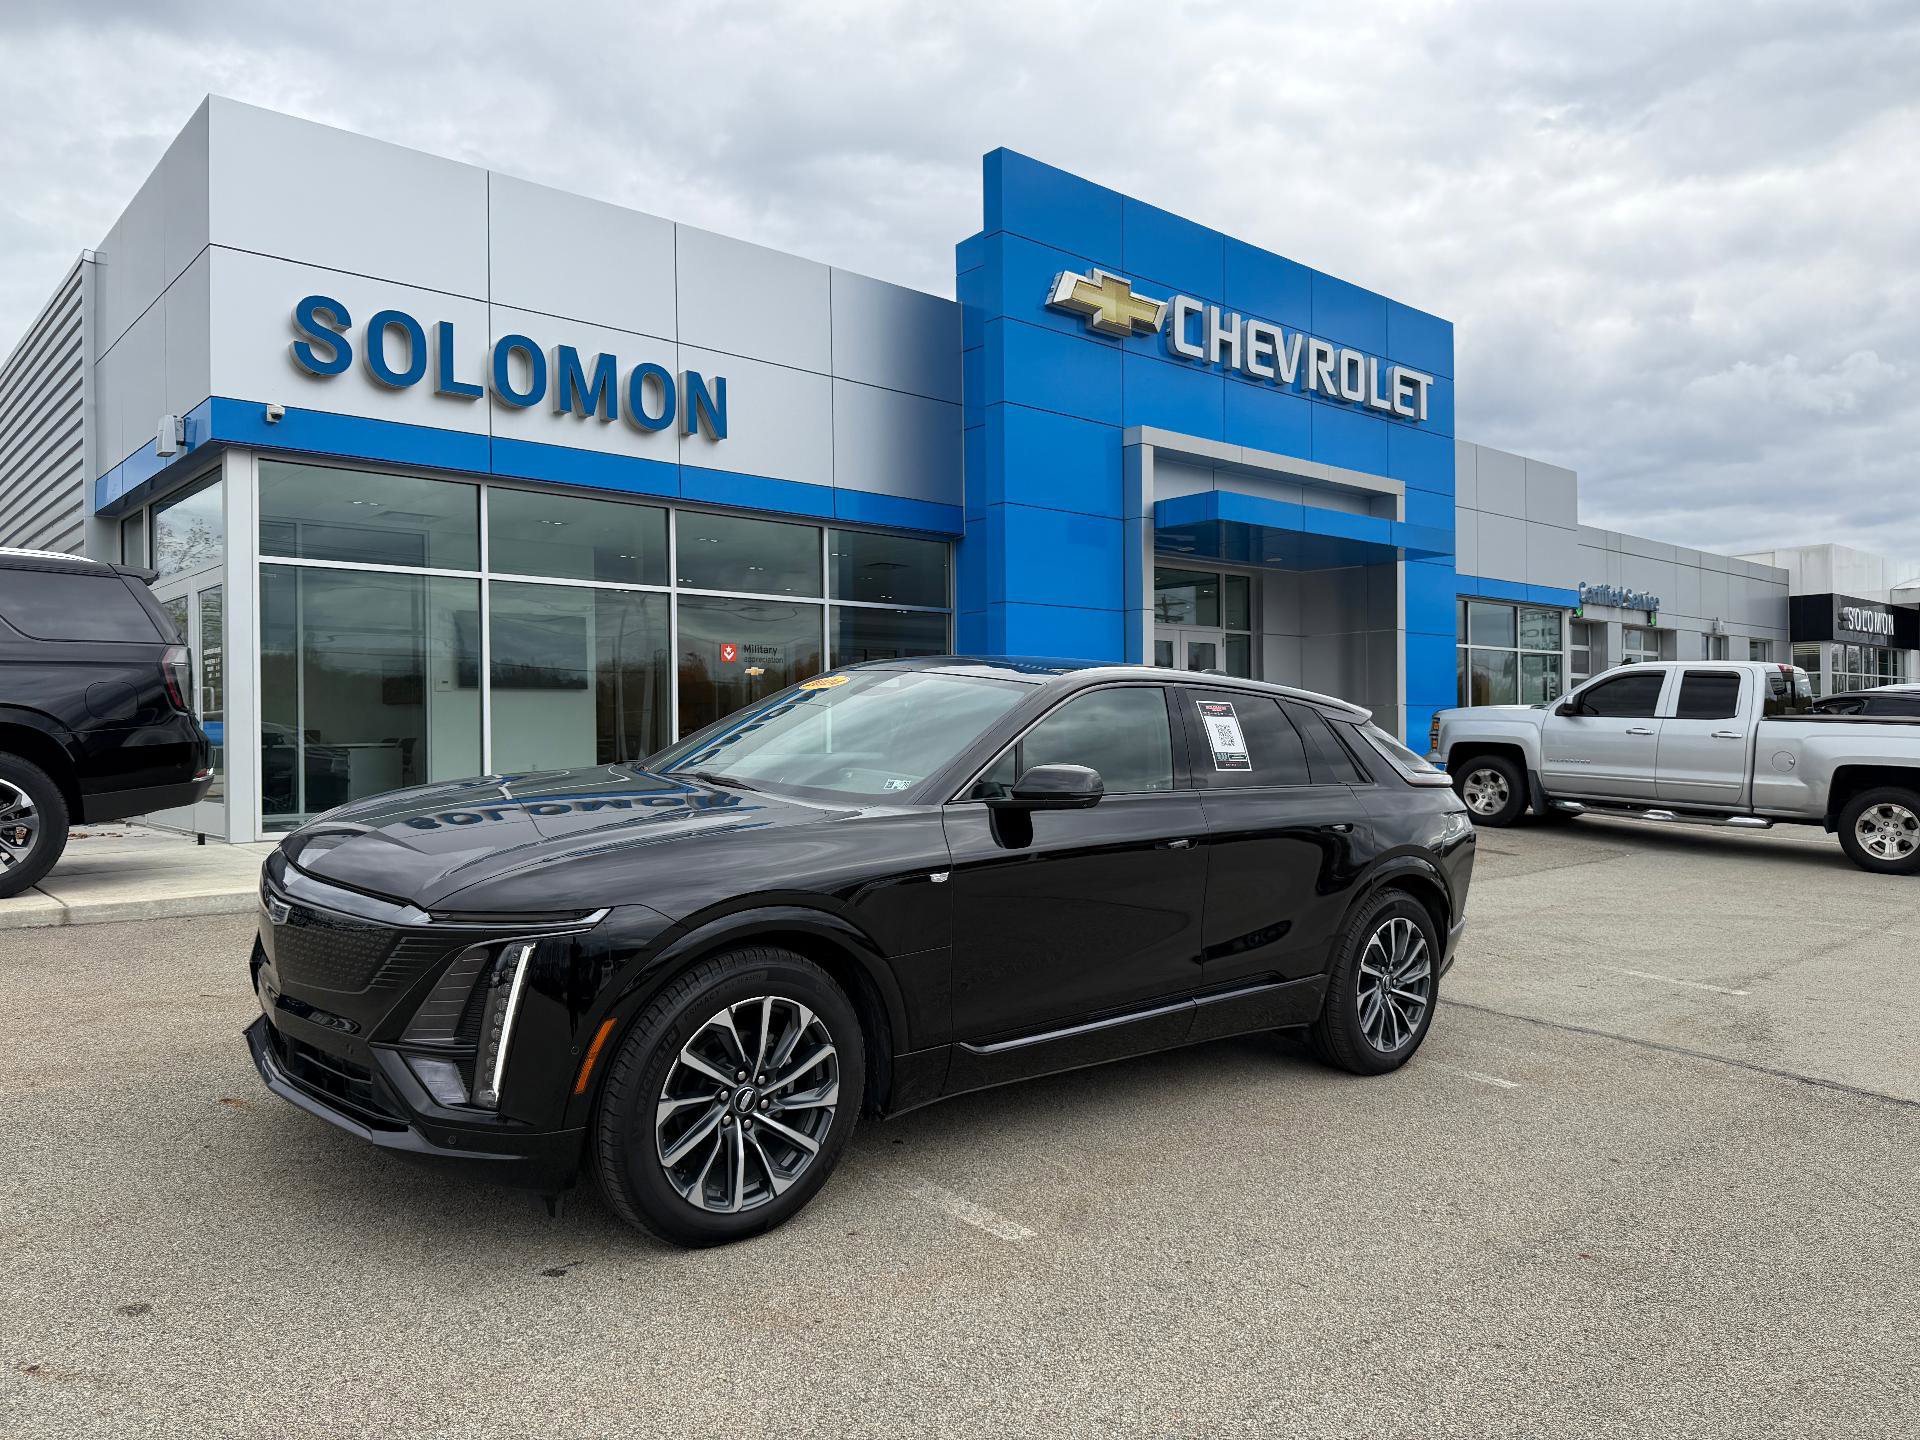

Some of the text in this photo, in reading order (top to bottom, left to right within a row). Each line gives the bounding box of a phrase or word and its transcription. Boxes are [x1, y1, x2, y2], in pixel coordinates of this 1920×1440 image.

[289, 295, 728, 441] SOLOMON
[1167, 294, 1433, 422] CHEVROLET
[1579, 582, 1624, 608] Certified
[1846, 605, 1896, 635] SOLOMON
[743, 643, 778, 656] Military
